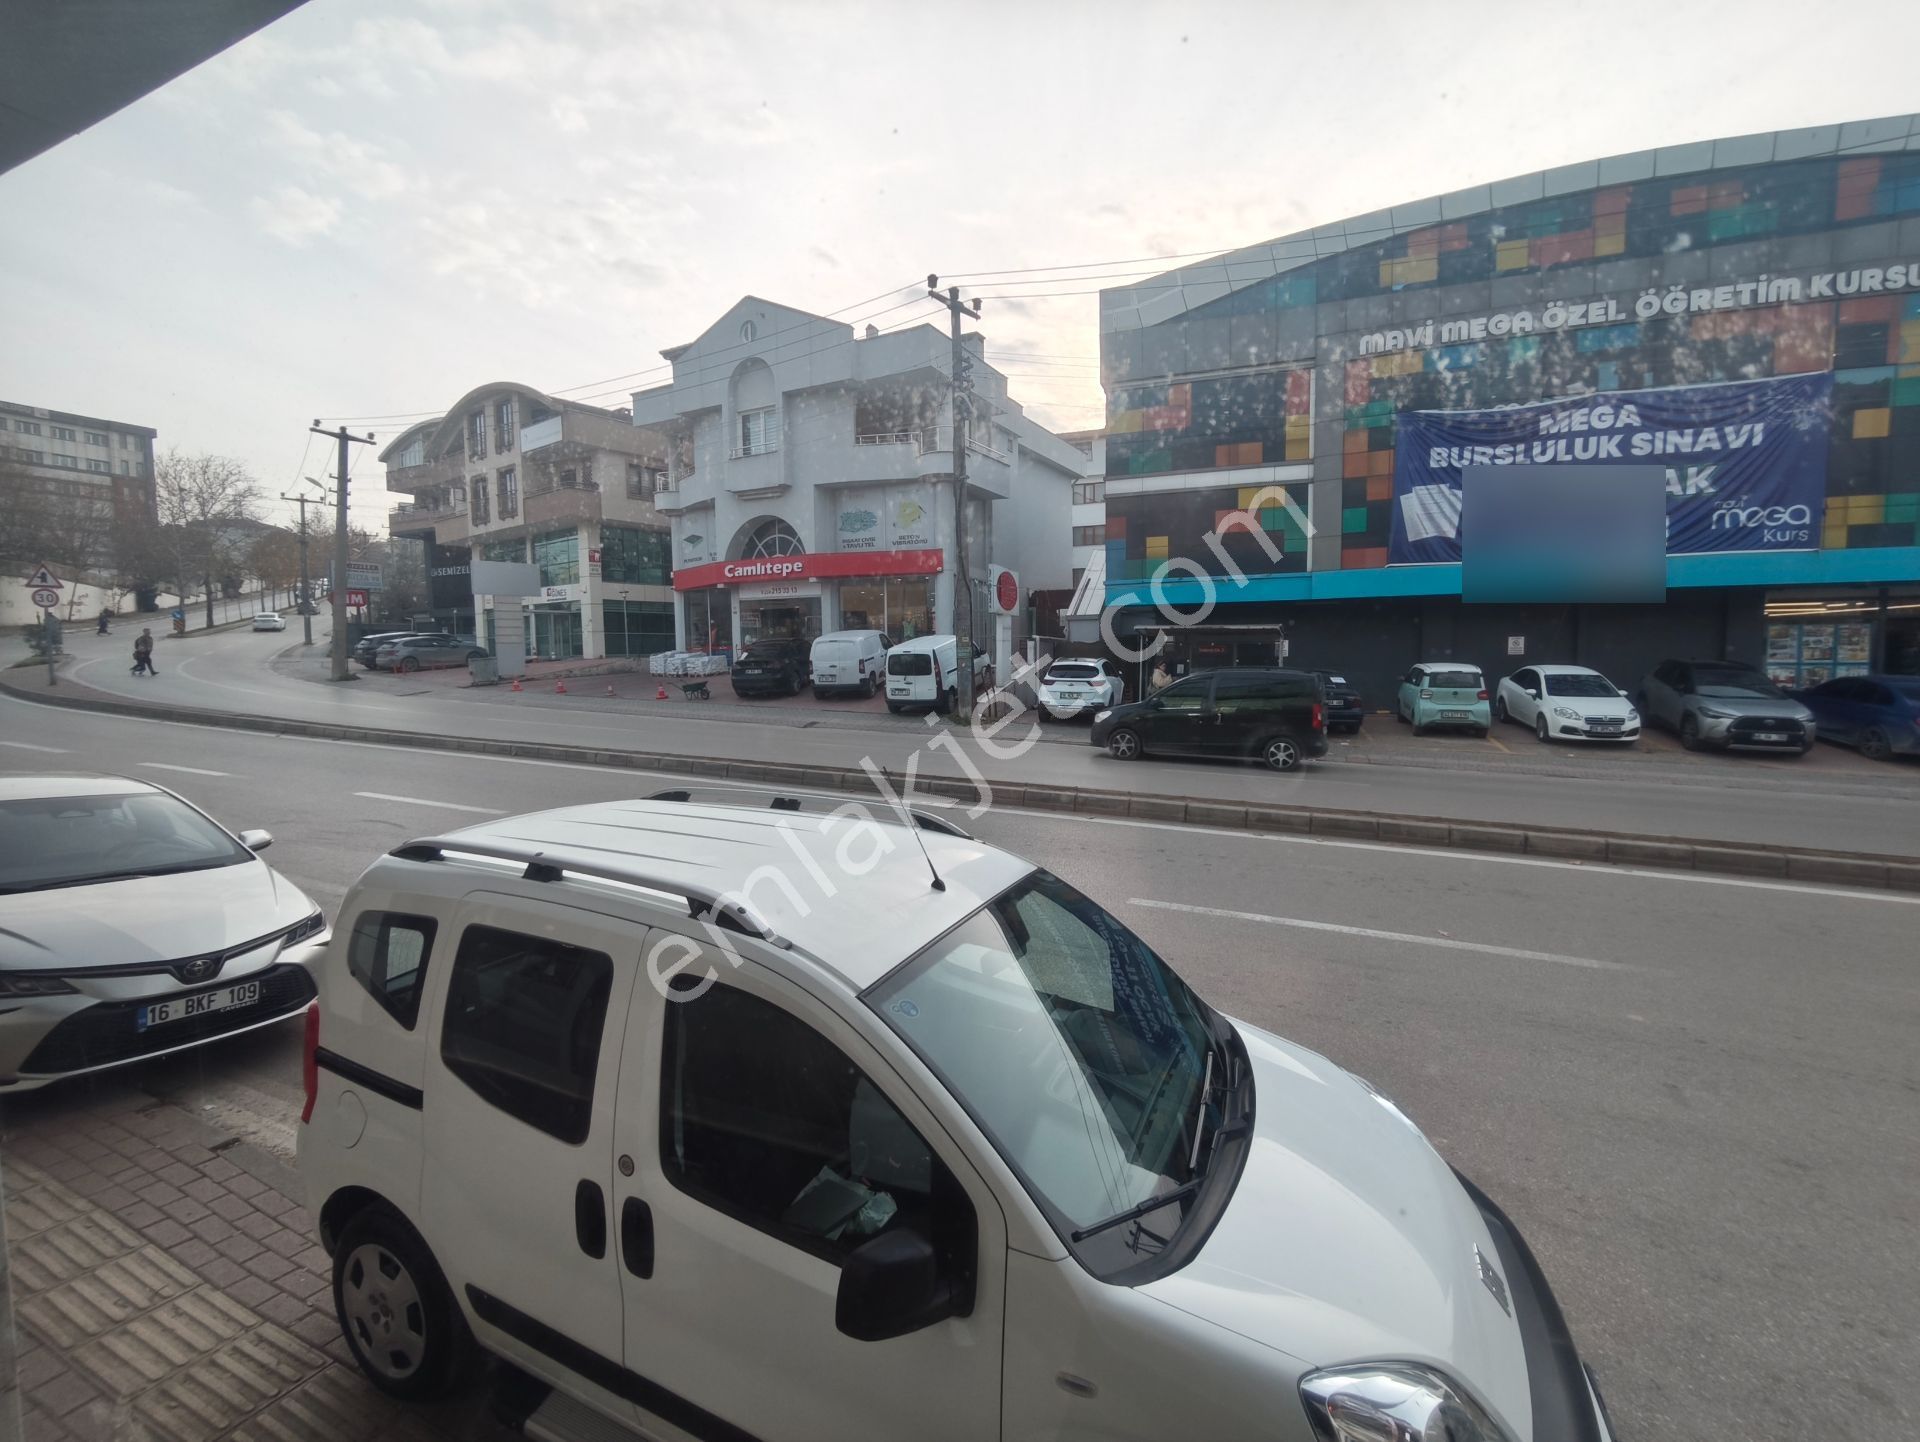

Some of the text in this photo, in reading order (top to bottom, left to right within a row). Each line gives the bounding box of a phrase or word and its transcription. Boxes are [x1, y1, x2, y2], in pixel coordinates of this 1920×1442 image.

[1359, 320, 1433, 355] MAVİ
[1441, 311, 1533, 343] MEGA
[1542, 299, 1626, 329] ÖZEL
[1635, 274, 1801, 317] ÖĞRETİM
[1539, 405, 1642, 435] MEGA
[1429, 422, 1765, 468] BURSLULUK SINAVI
[1711, 504, 1810, 530] mega
[37, 593, 54, 603] 30
[149, 983, 257, 1023] 16 BKF 109
